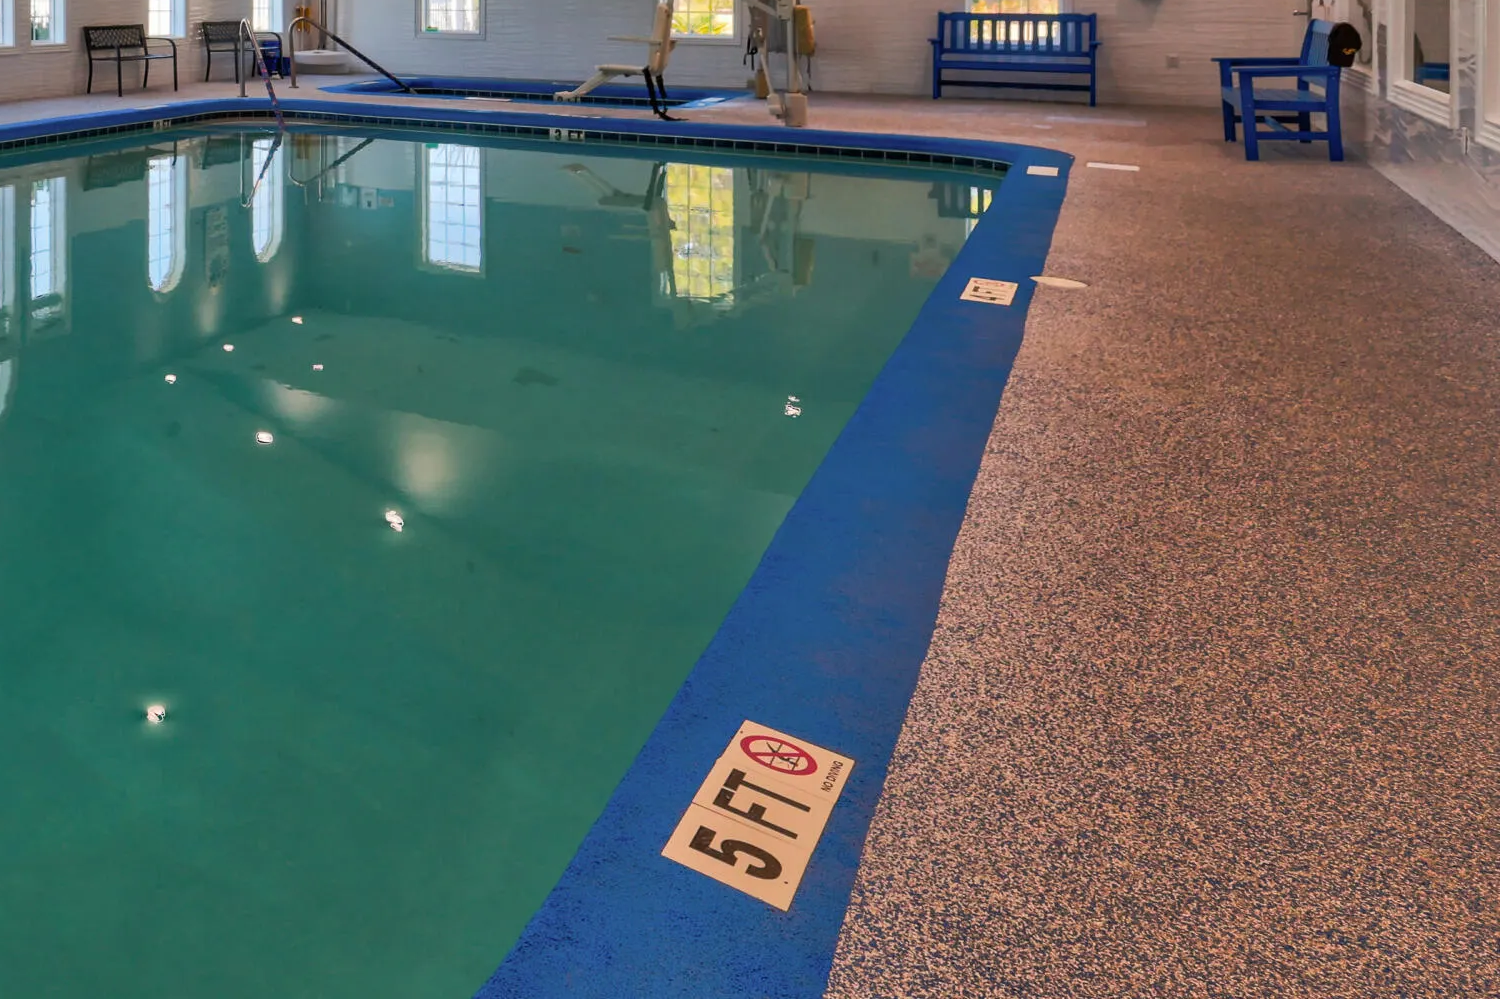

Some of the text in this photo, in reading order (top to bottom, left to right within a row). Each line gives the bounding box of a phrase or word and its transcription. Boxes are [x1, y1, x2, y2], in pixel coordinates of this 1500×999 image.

[820, 760, 844, 793] NO DIVING
[688, 767, 812, 881] 5 FT
